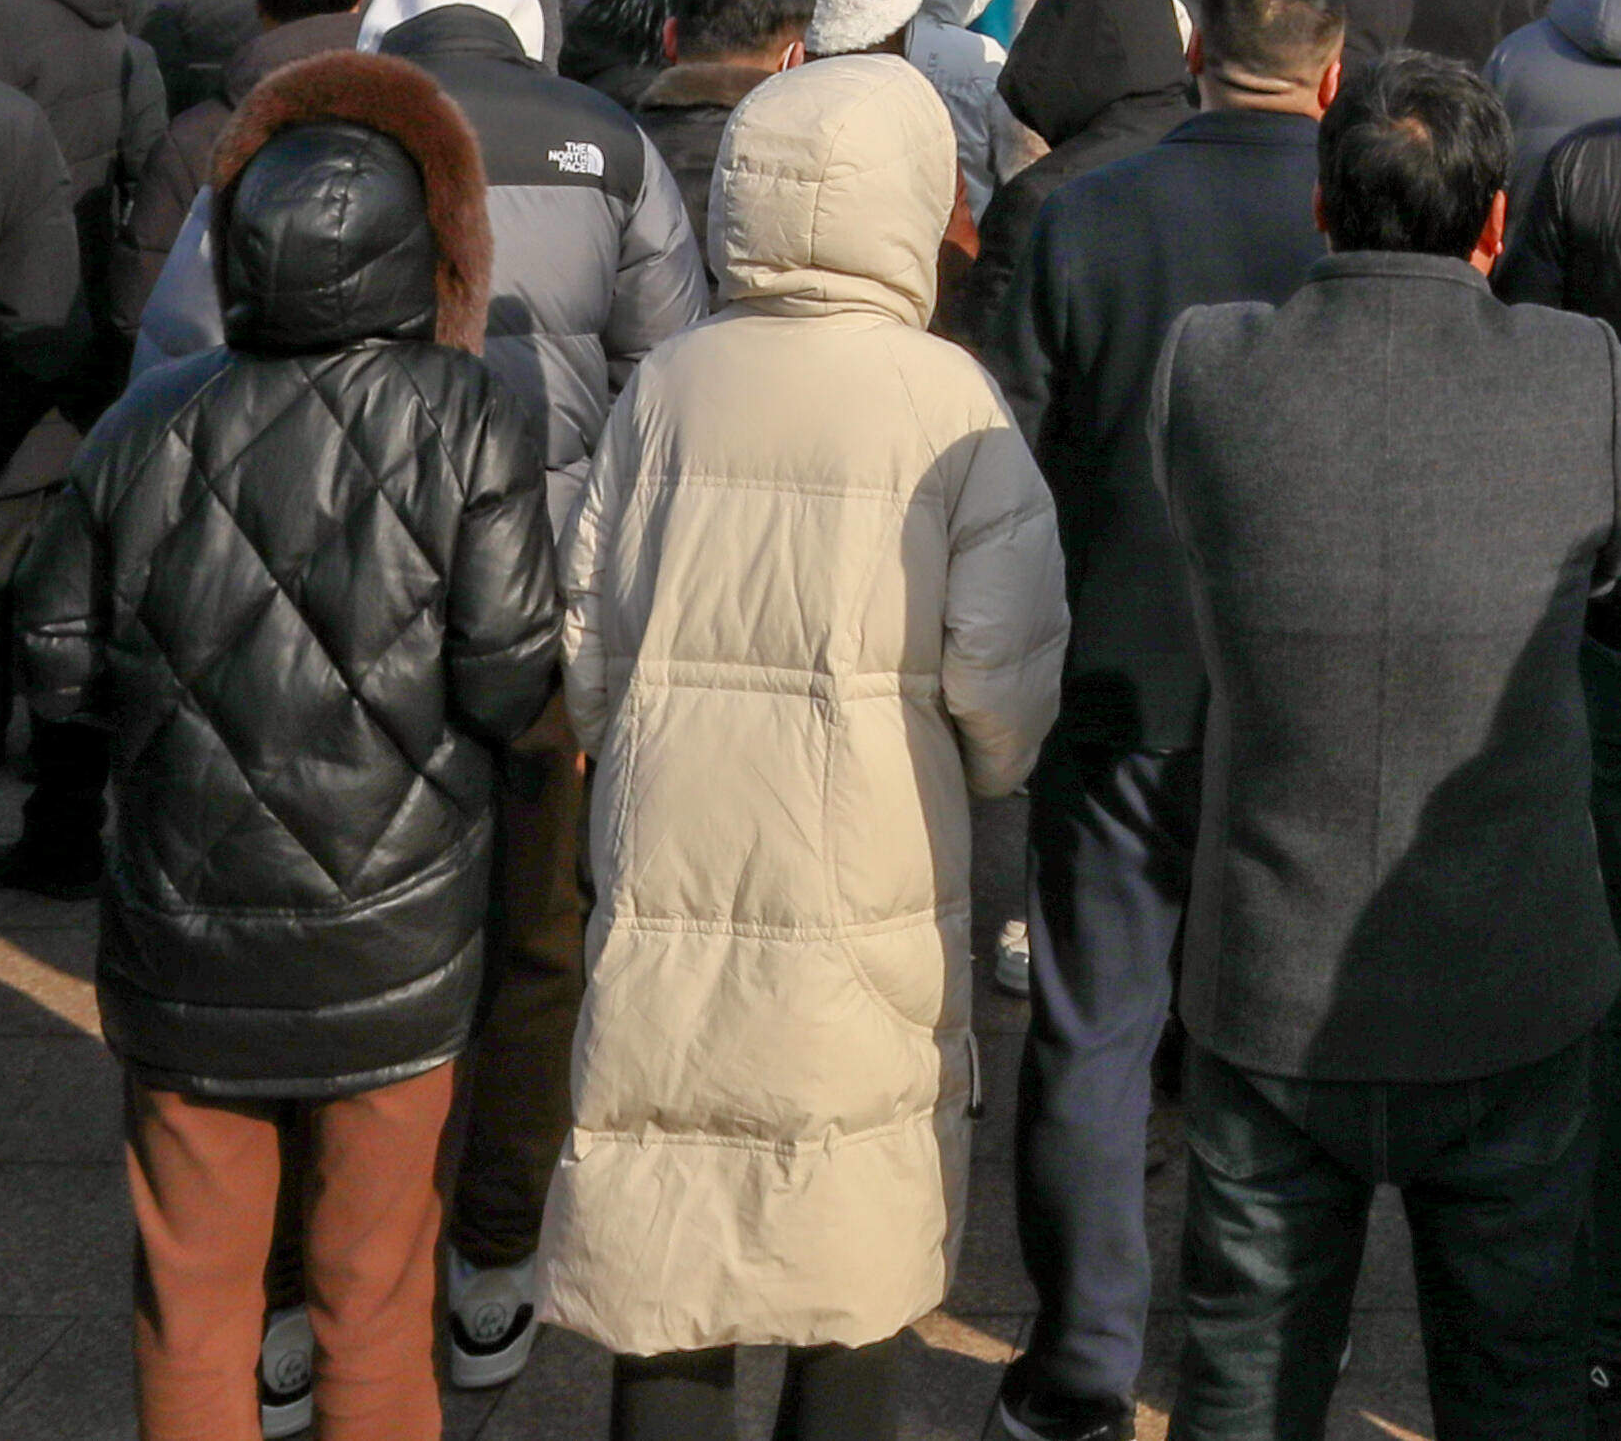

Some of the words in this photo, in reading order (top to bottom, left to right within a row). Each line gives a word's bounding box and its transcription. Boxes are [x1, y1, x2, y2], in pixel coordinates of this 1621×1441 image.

[565, 141, 588, 153] THE
[548, 149, 588, 164] NORTH
[559, 161, 588, 174] FACE
